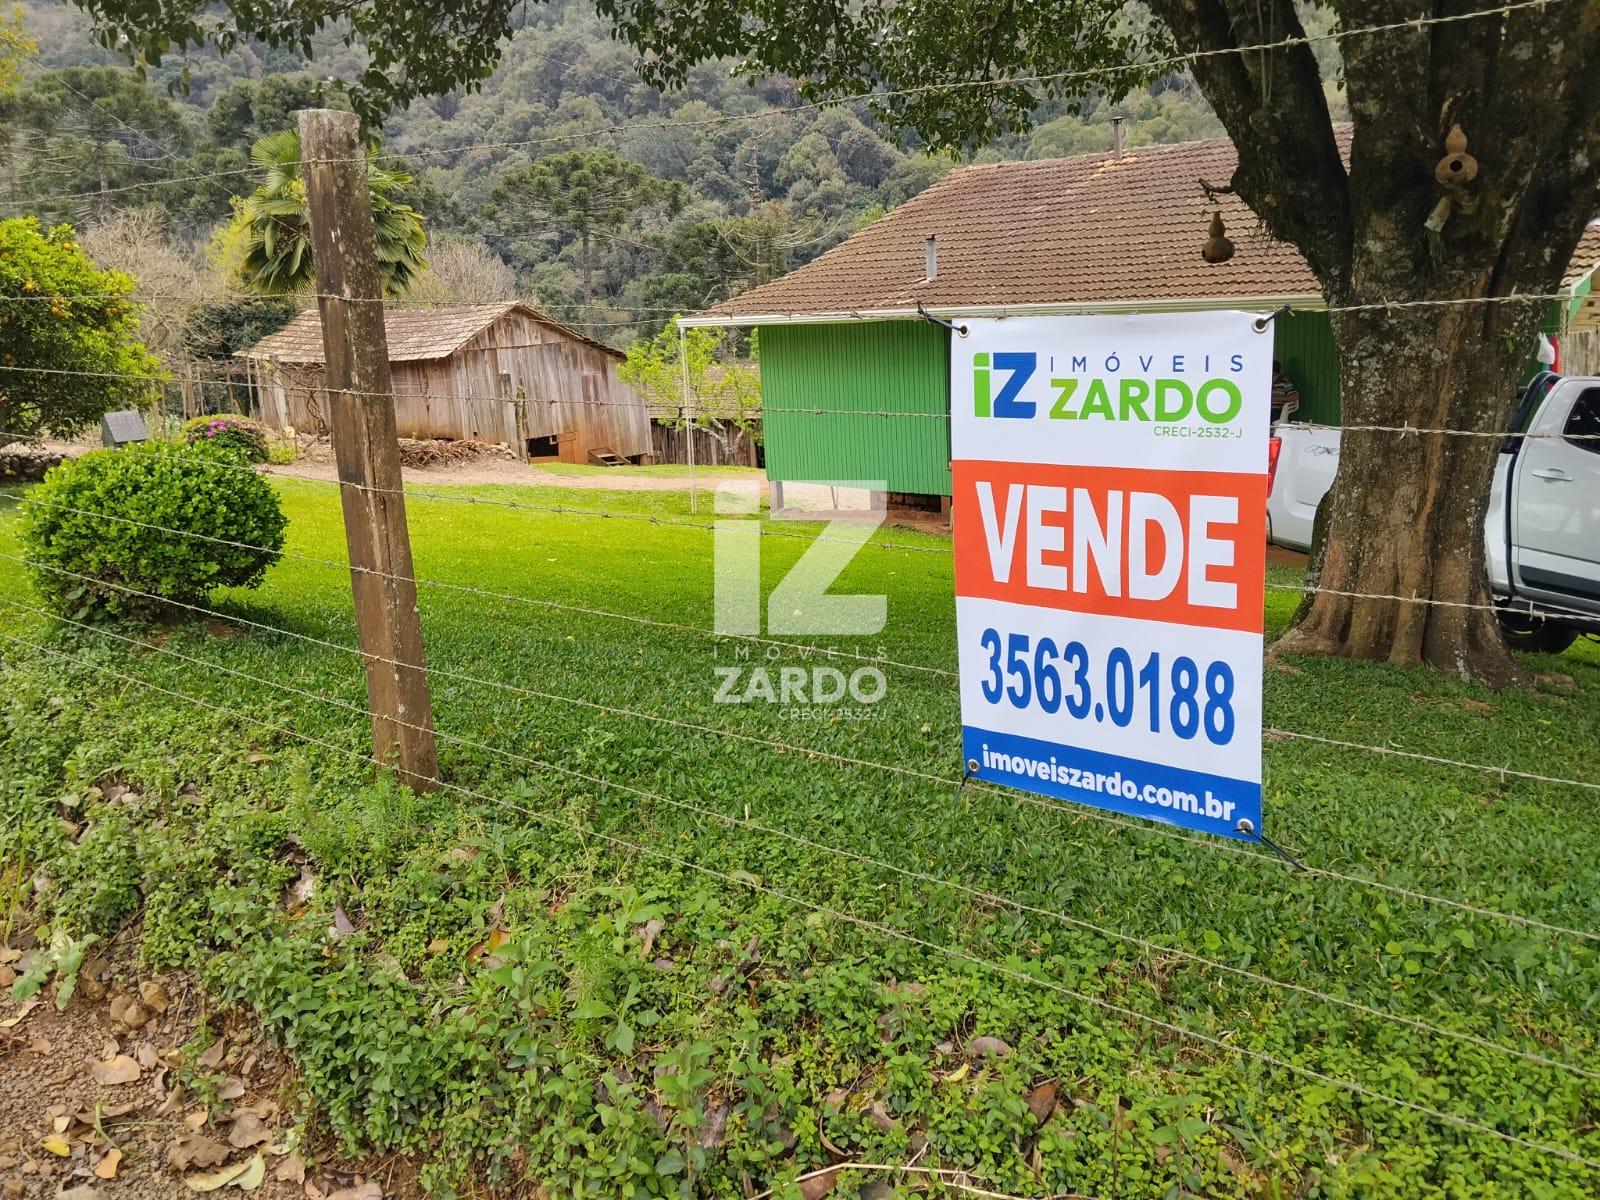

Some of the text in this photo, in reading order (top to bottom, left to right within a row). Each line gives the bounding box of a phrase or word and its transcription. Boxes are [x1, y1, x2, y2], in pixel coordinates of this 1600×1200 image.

[1050, 352, 1243, 372] IMÓVEIS
[1049, 378, 1242, 424] ZARDO
[1153, 426, 1243, 438] CRECI-2532-J
[975, 481, 1239, 609] VENDE
[980, 628, 1235, 746] 3563.0188
[982, 744, 1236, 821] imoveiszardo.com.br
